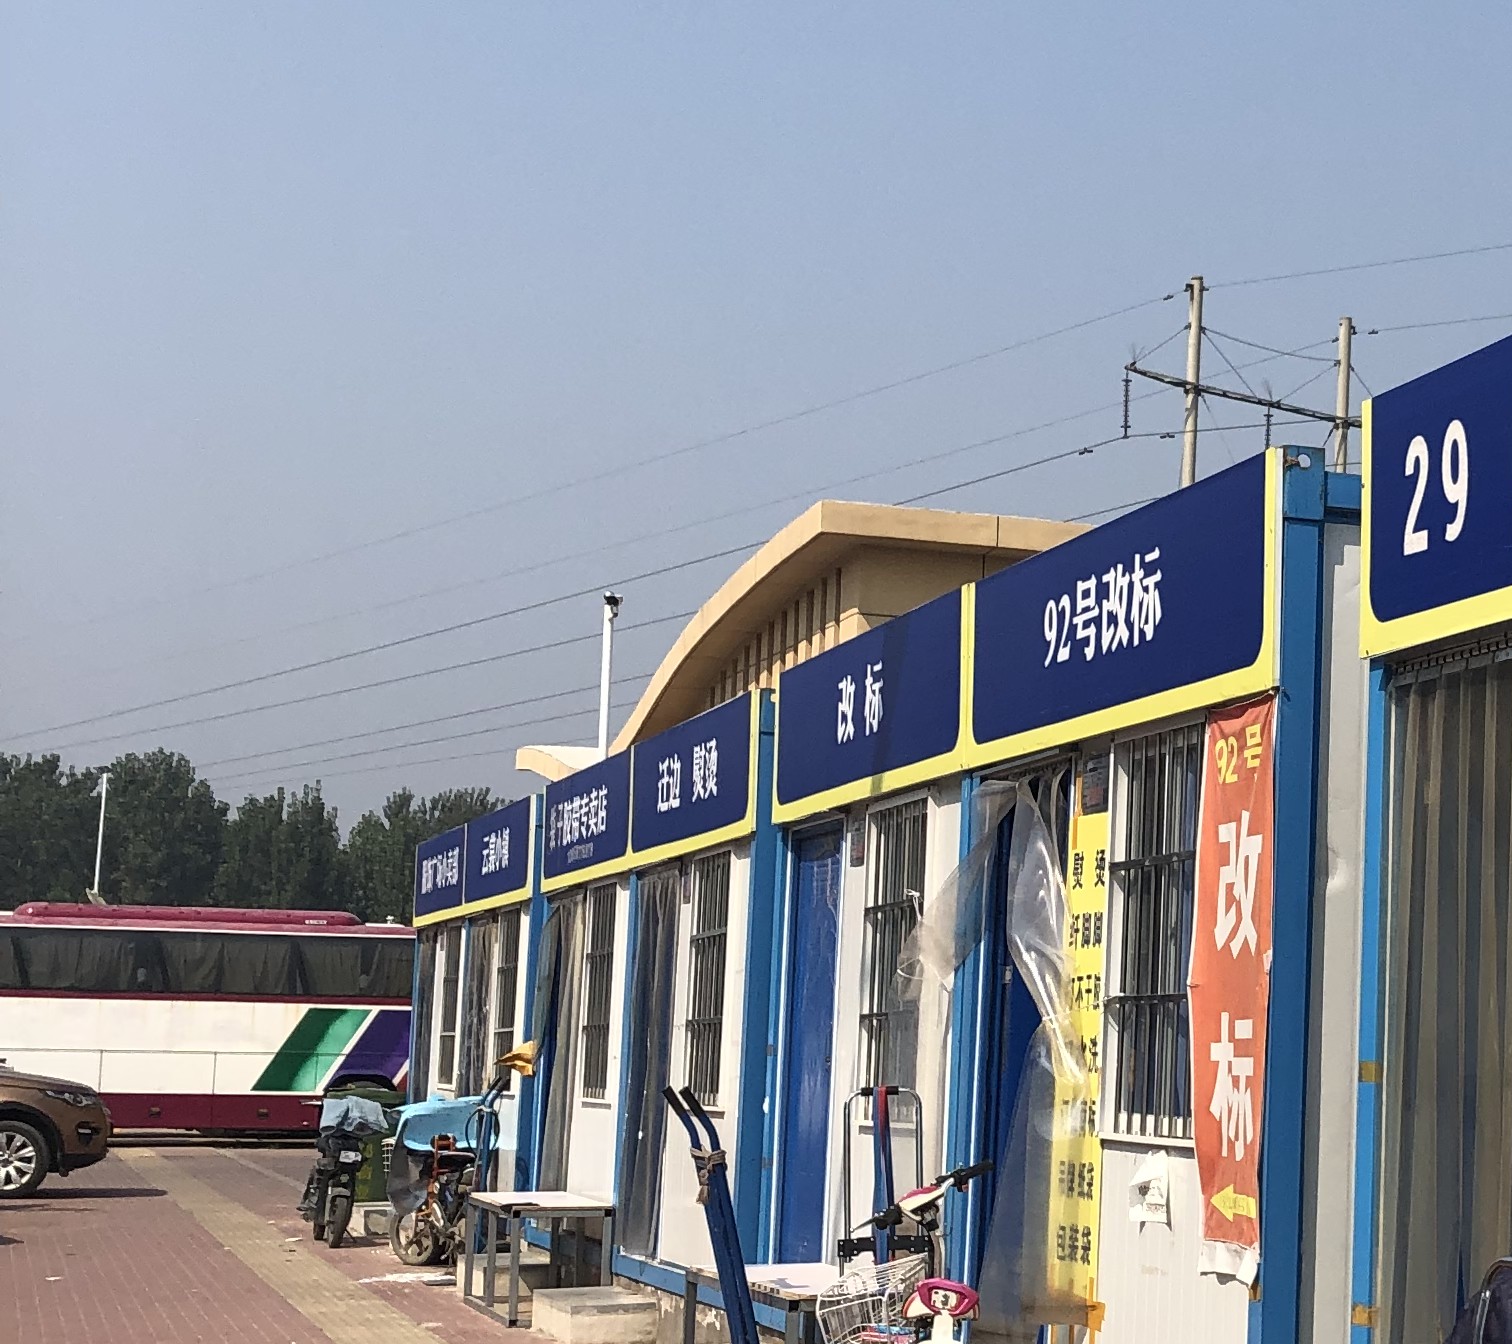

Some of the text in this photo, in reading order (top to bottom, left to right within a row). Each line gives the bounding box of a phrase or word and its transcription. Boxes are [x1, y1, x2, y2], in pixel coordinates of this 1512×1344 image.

[1403, 419, 1470, 557] 29
[1043, 546, 1162, 668] 92号改标
[836, 659, 884, 745] 改标
[1214, 723, 1263, 785] 92号
[692, 737, 718, 803] 熨烫
[1209, 810, 1263, 1162] 改标
